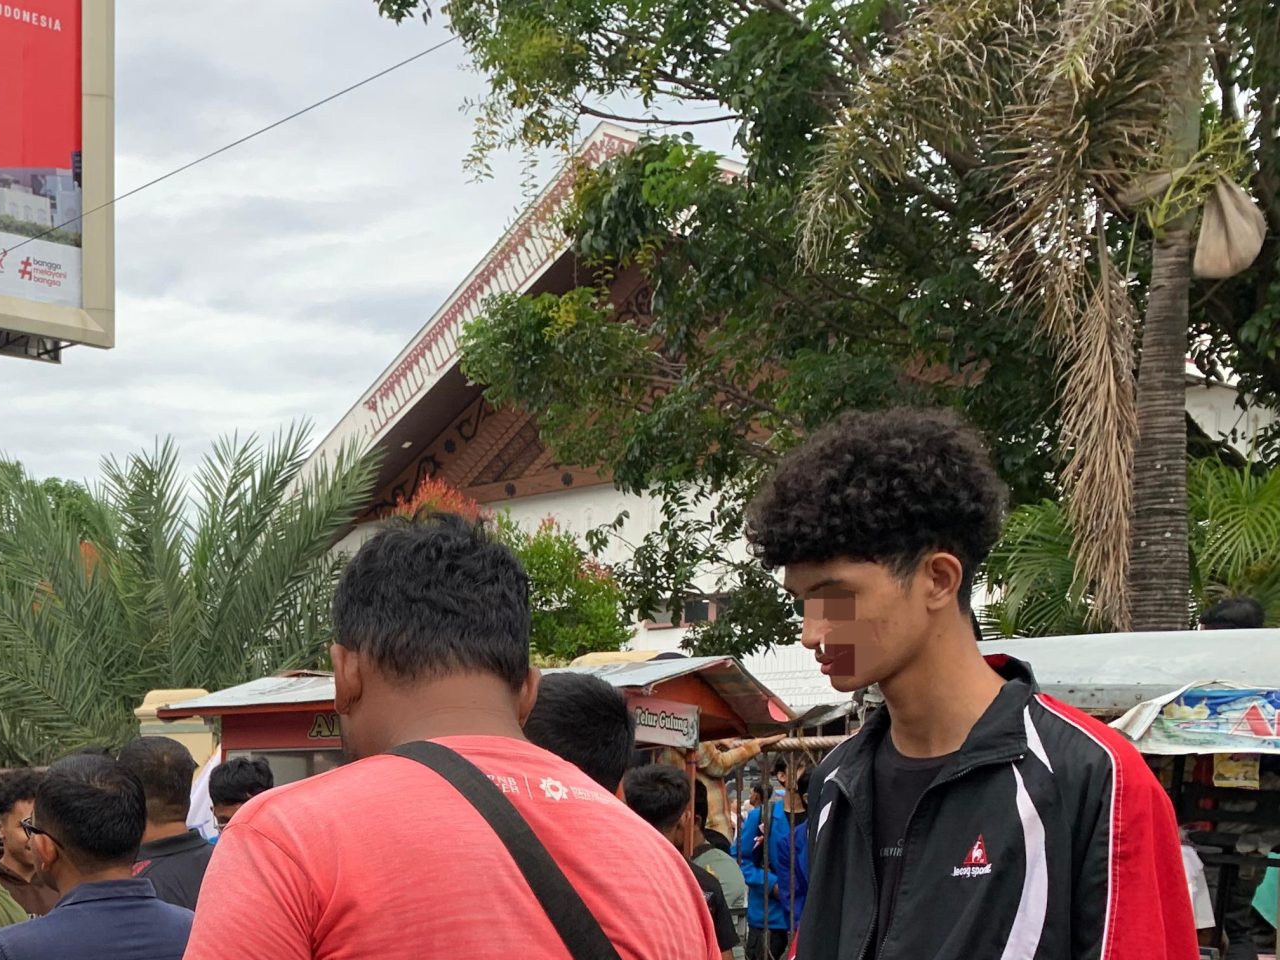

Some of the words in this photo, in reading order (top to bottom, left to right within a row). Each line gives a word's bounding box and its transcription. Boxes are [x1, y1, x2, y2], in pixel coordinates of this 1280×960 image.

[33, 257, 61, 271] bangga
[635, 707, 658, 727] Telur
[659, 711, 688, 736] Gulung
[1229, 701, 1280, 739] A
